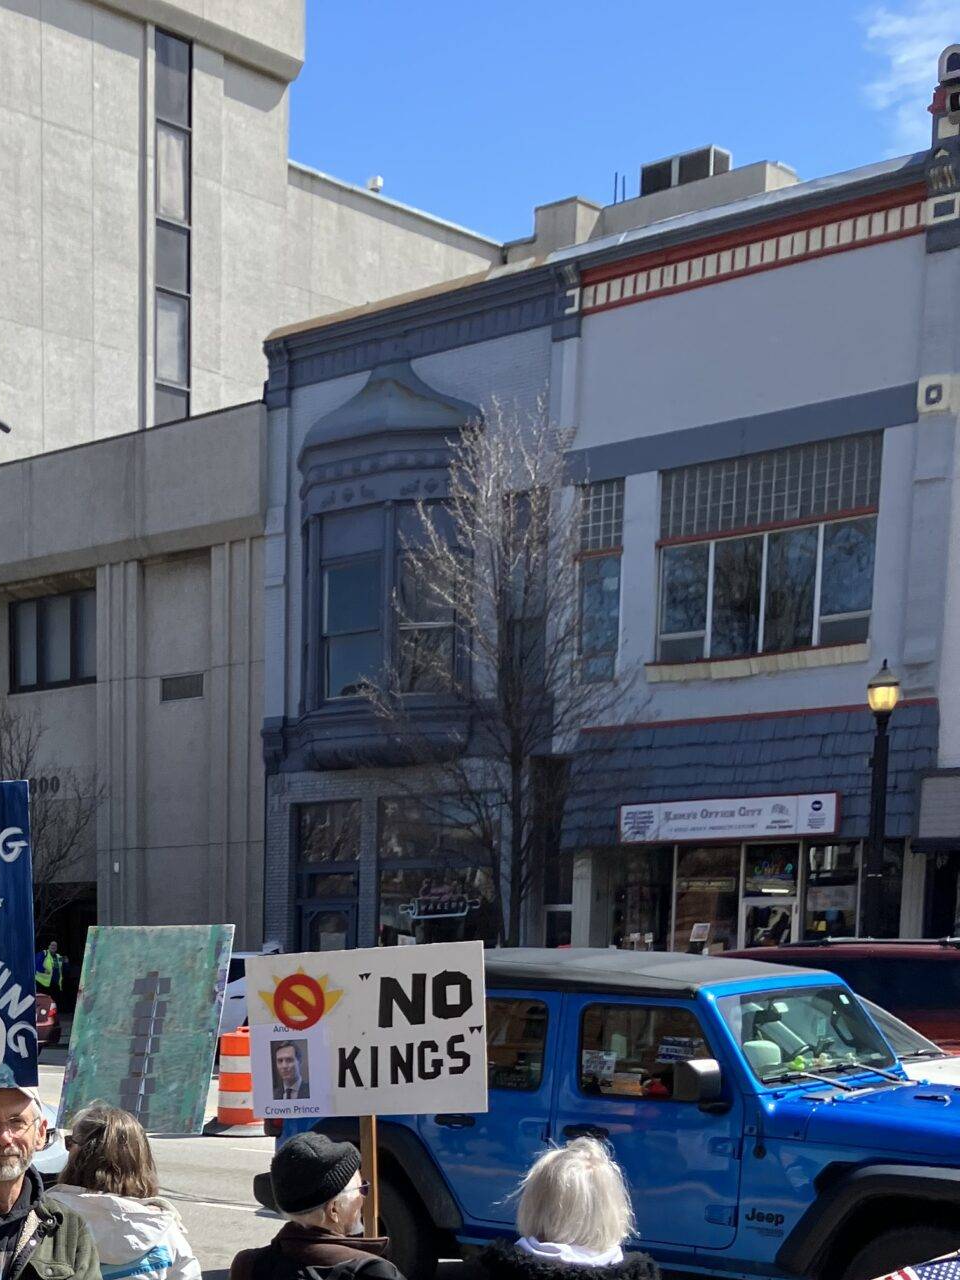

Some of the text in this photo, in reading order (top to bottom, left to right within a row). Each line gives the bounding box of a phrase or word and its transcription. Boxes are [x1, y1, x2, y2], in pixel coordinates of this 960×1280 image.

[265, 1105, 320, 1115] Crown Prince
[745, 1208, 785, 1226] Jeep
